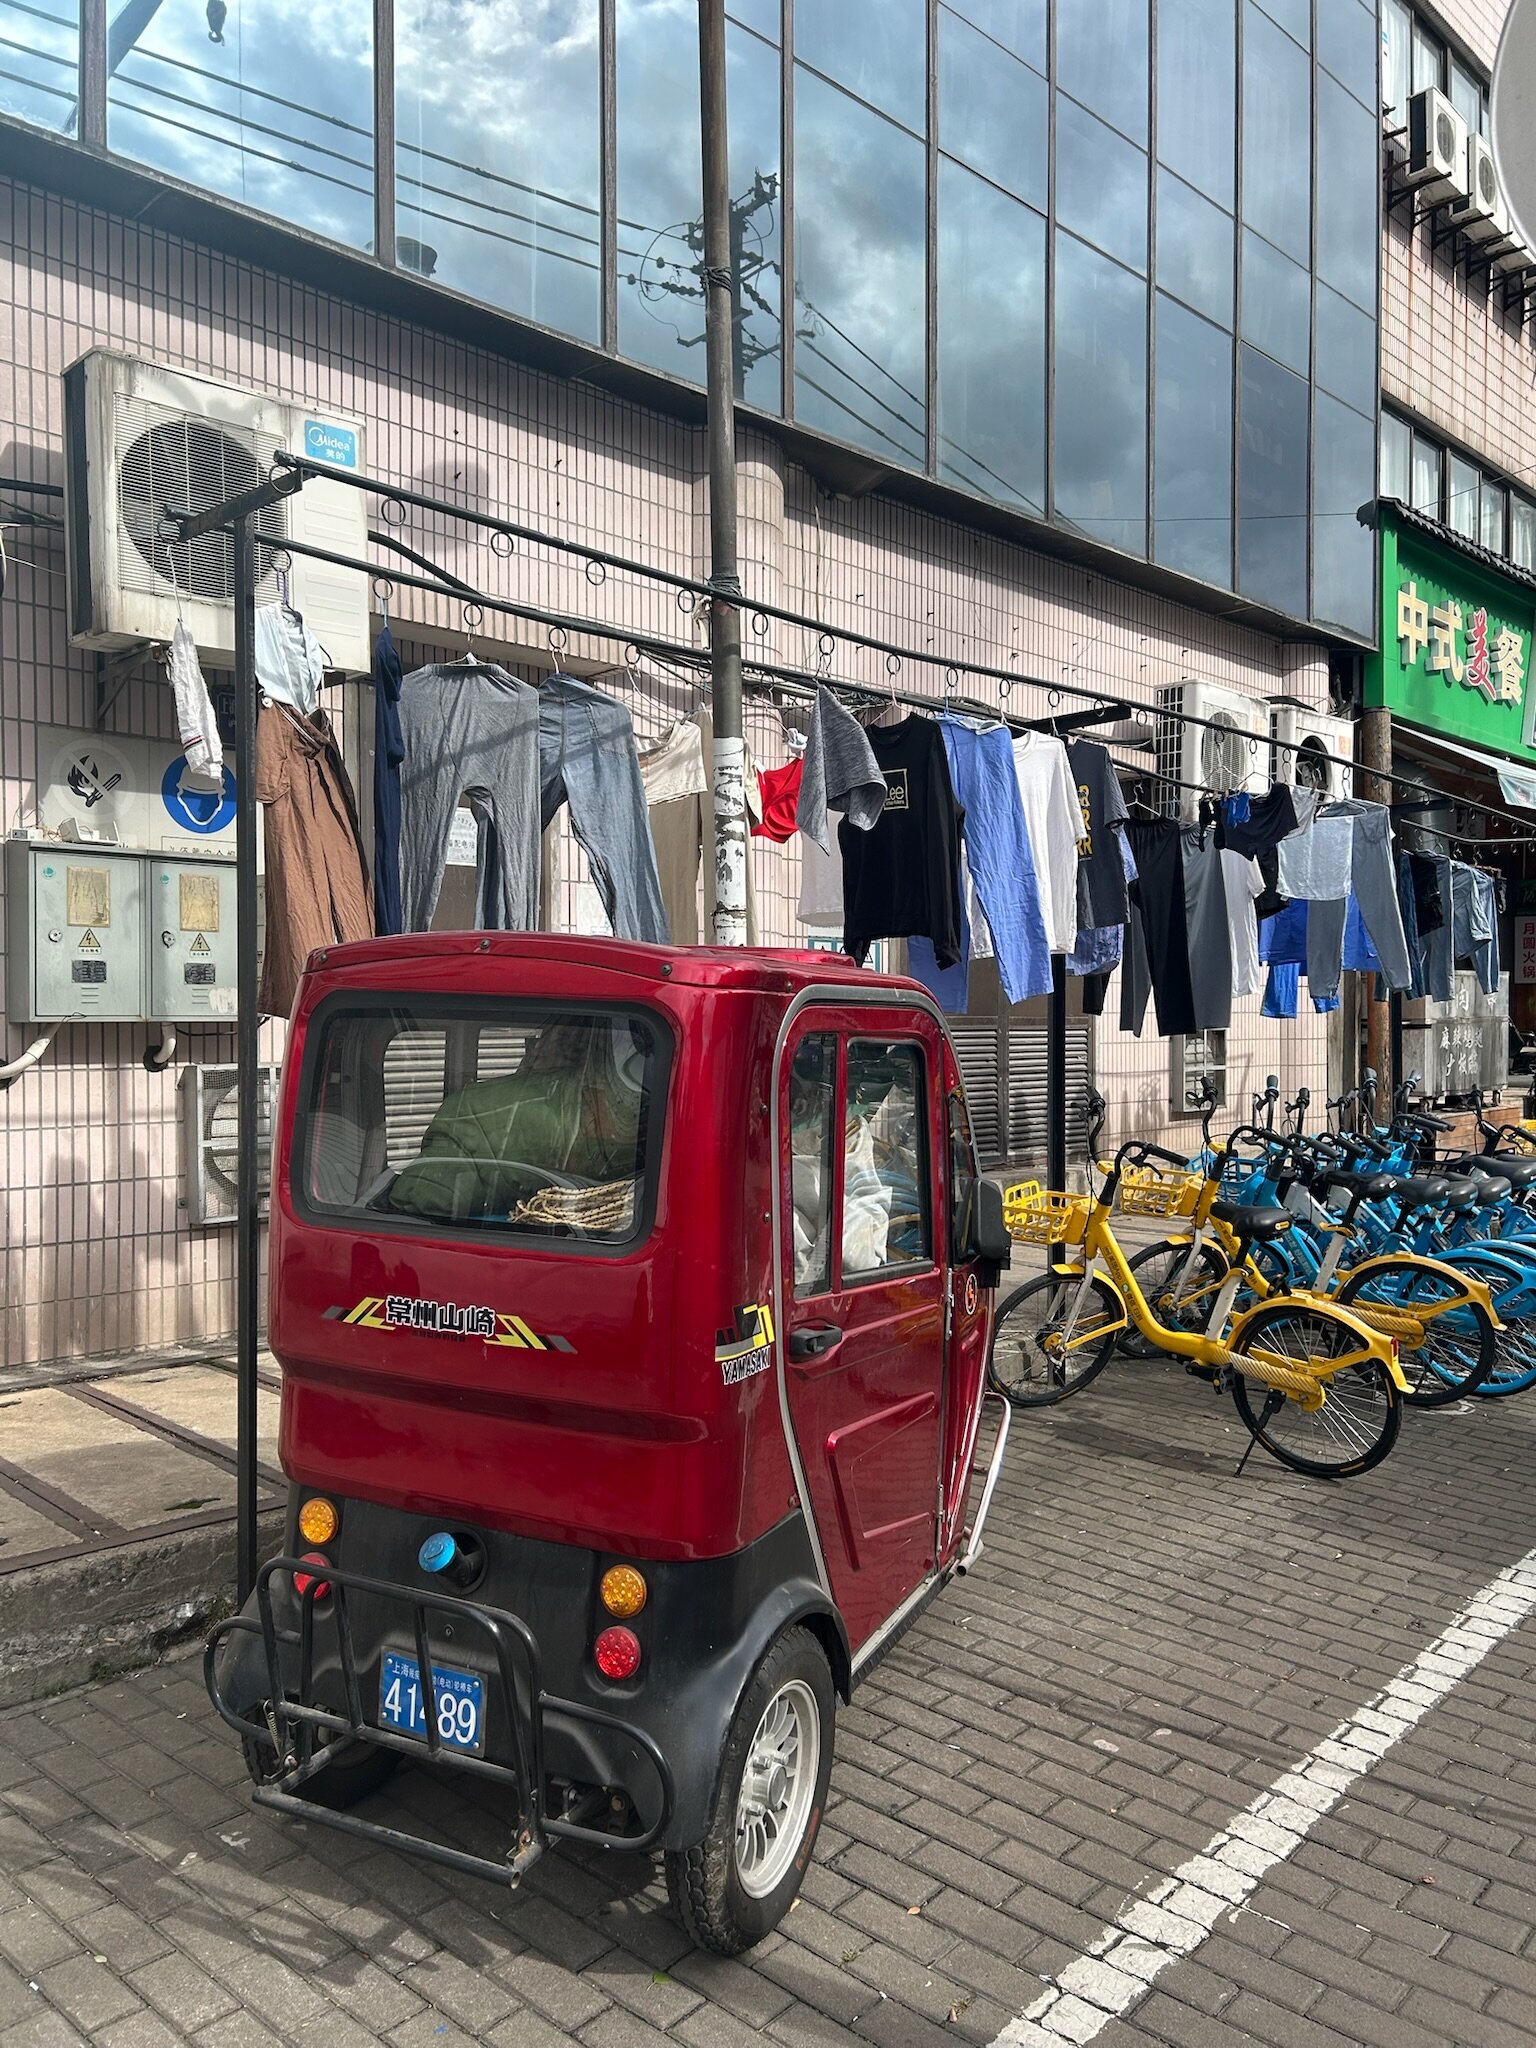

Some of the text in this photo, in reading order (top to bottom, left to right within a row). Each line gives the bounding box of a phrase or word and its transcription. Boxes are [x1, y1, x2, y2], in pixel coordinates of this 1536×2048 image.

[309, 427, 351, 452] Midea
[1397, 580, 1524, 705] 中式美餐
[386, 1295, 496, 1337] 常州山崎
[722, 1345, 771, 1386] YAMASAKI
